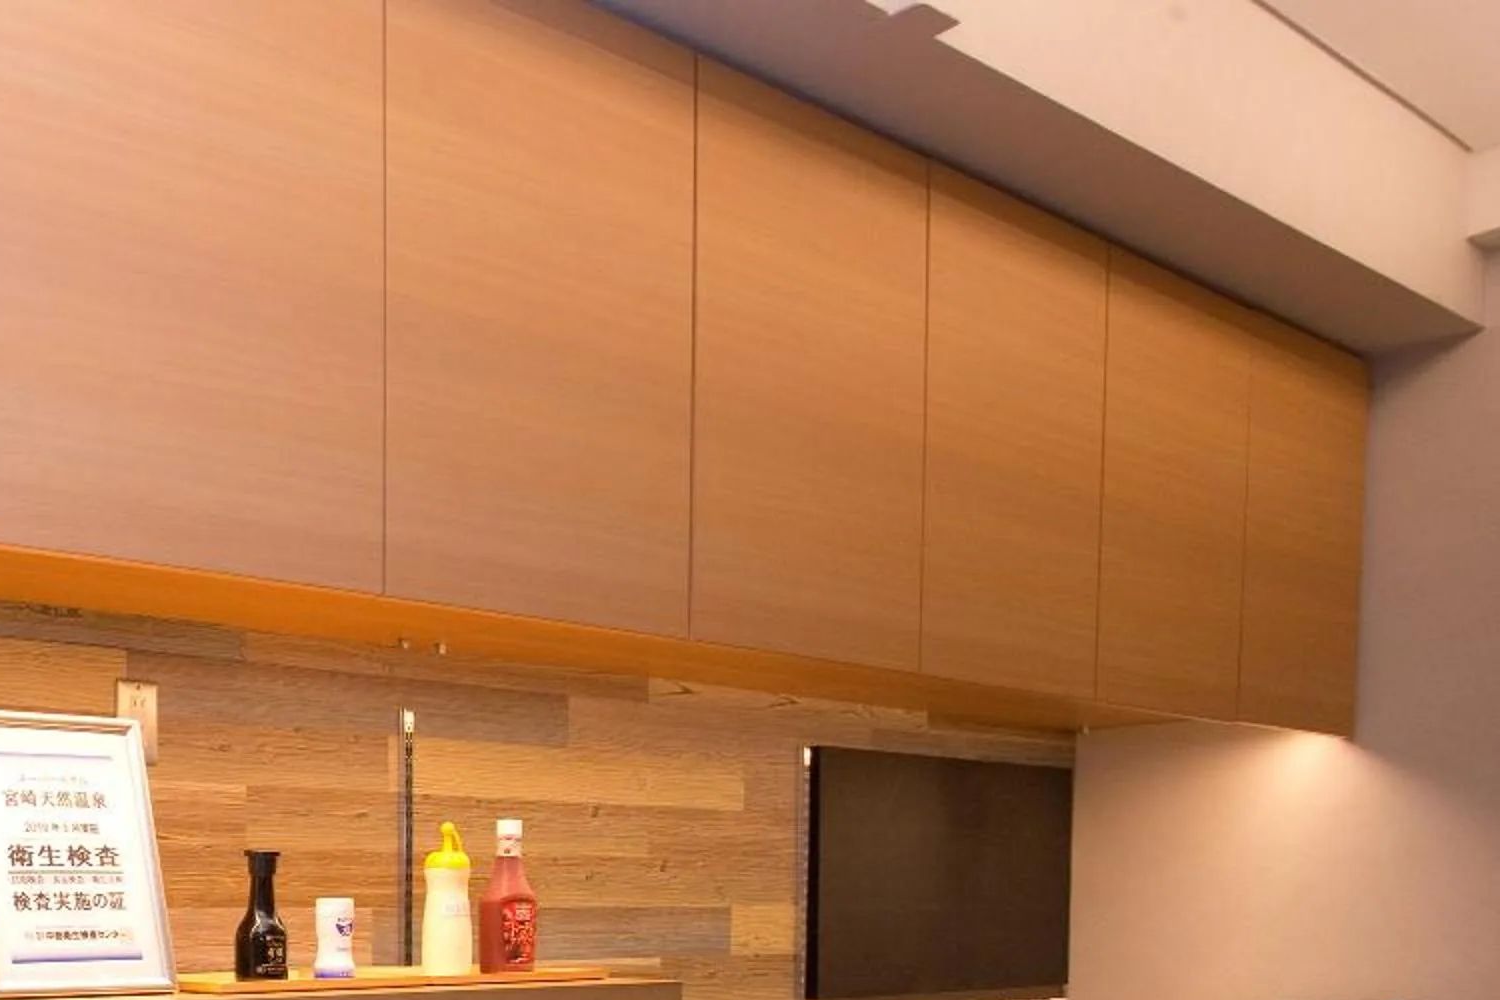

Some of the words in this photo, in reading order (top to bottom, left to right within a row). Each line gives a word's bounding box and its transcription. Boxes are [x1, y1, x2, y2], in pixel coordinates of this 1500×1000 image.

[3, 789, 108, 809] 宮崎天然温泉
[7, 844, 121, 868] 衛生検査
[12, 891, 127, 911] 検査実施の証
